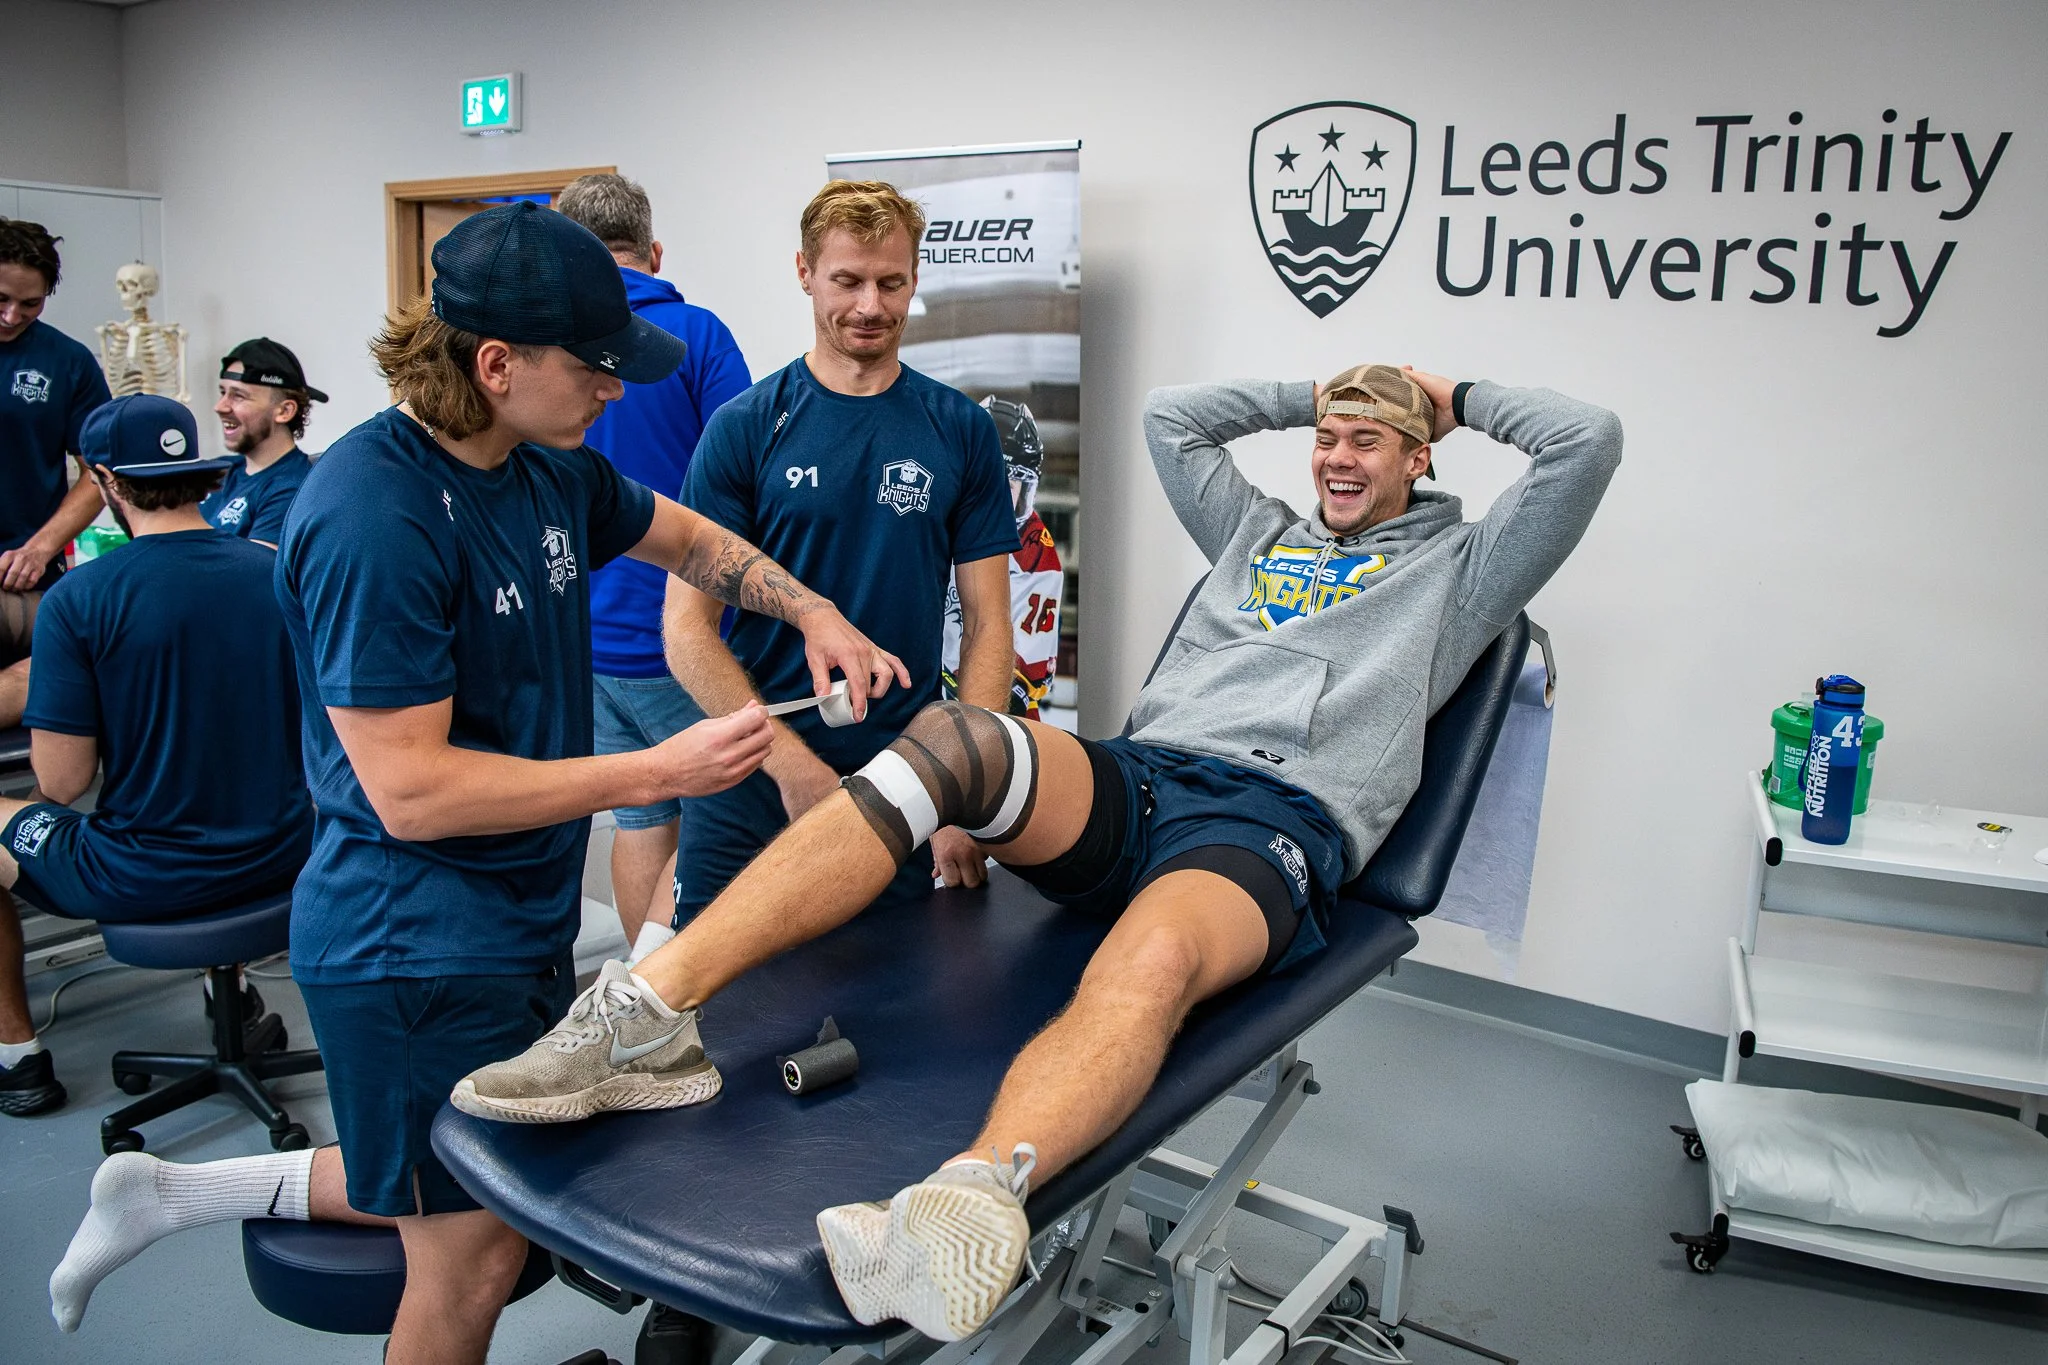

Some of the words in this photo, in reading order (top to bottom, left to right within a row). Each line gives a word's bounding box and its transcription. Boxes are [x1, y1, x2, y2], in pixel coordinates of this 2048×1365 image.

[1440, 113, 1669, 197] Leeds
[1695, 108, 2013, 222] Trinity
[919, 246, 1034, 264] AUER.COM
[1435, 212, 1958, 339] University
[785, 466, 819, 489] 91
[891, 482, 921, 494] LEEDS
[879, 484, 929, 511] KNIGHTS
[495, 581, 524, 616] 41
[1808, 735, 1833, 818] NUTRITION
